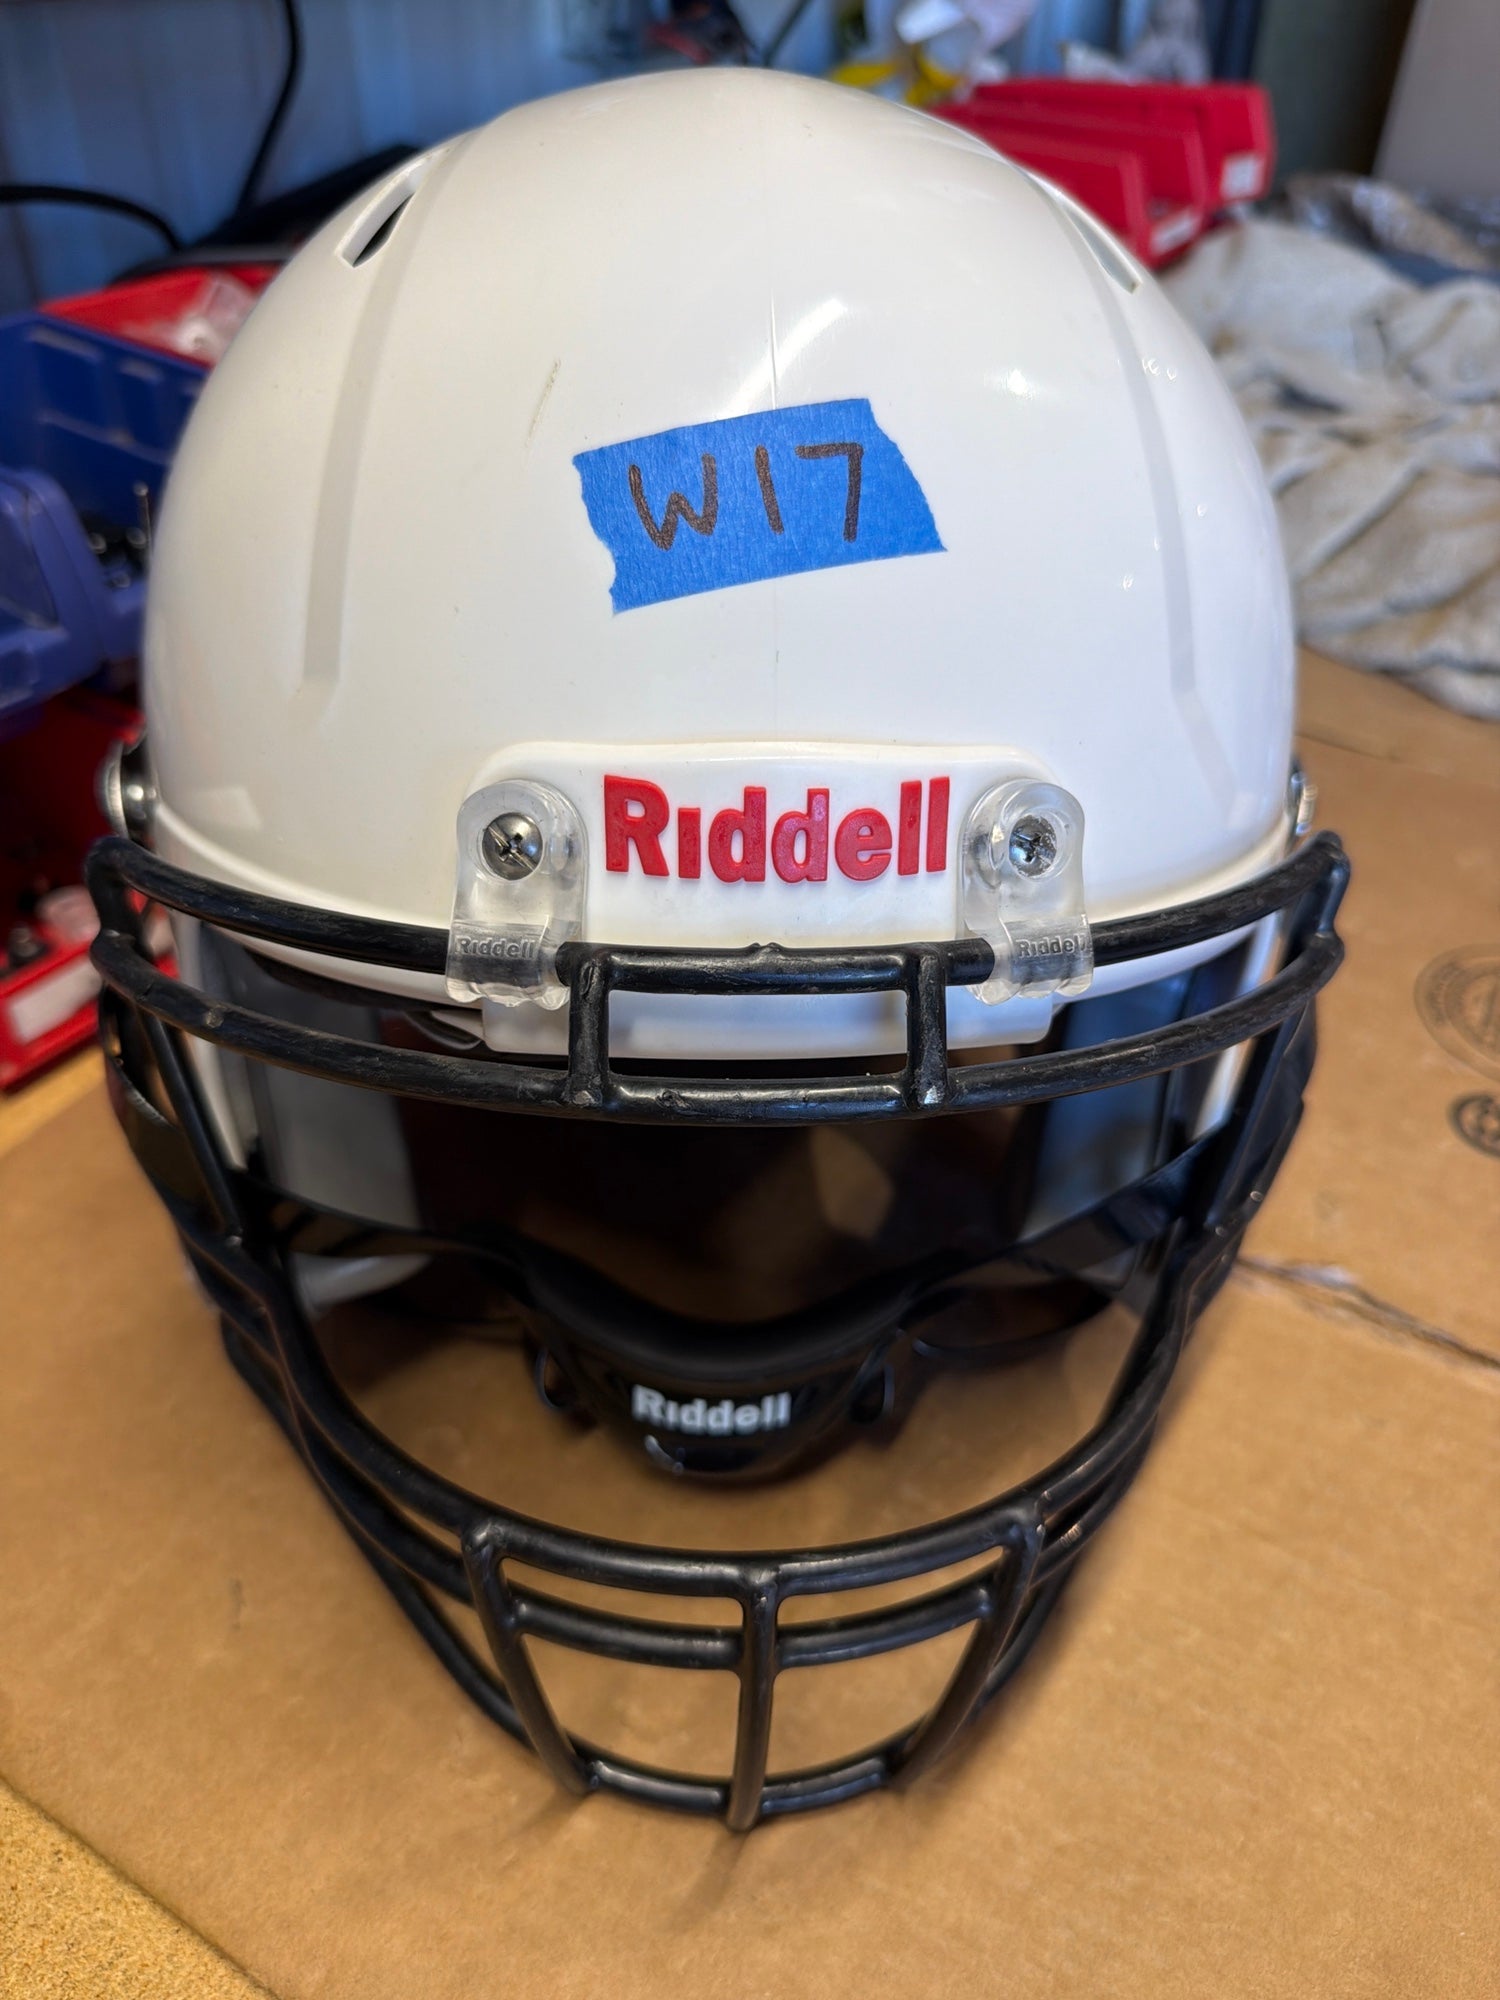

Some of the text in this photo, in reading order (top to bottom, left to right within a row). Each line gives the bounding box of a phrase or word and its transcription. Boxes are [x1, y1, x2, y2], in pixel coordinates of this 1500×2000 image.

[629, 442, 864, 550] W17
[604, 774, 950, 883] Riddell
[456, 935, 536, 960] Riddell
[631, 1384, 792, 1436] Riddell
